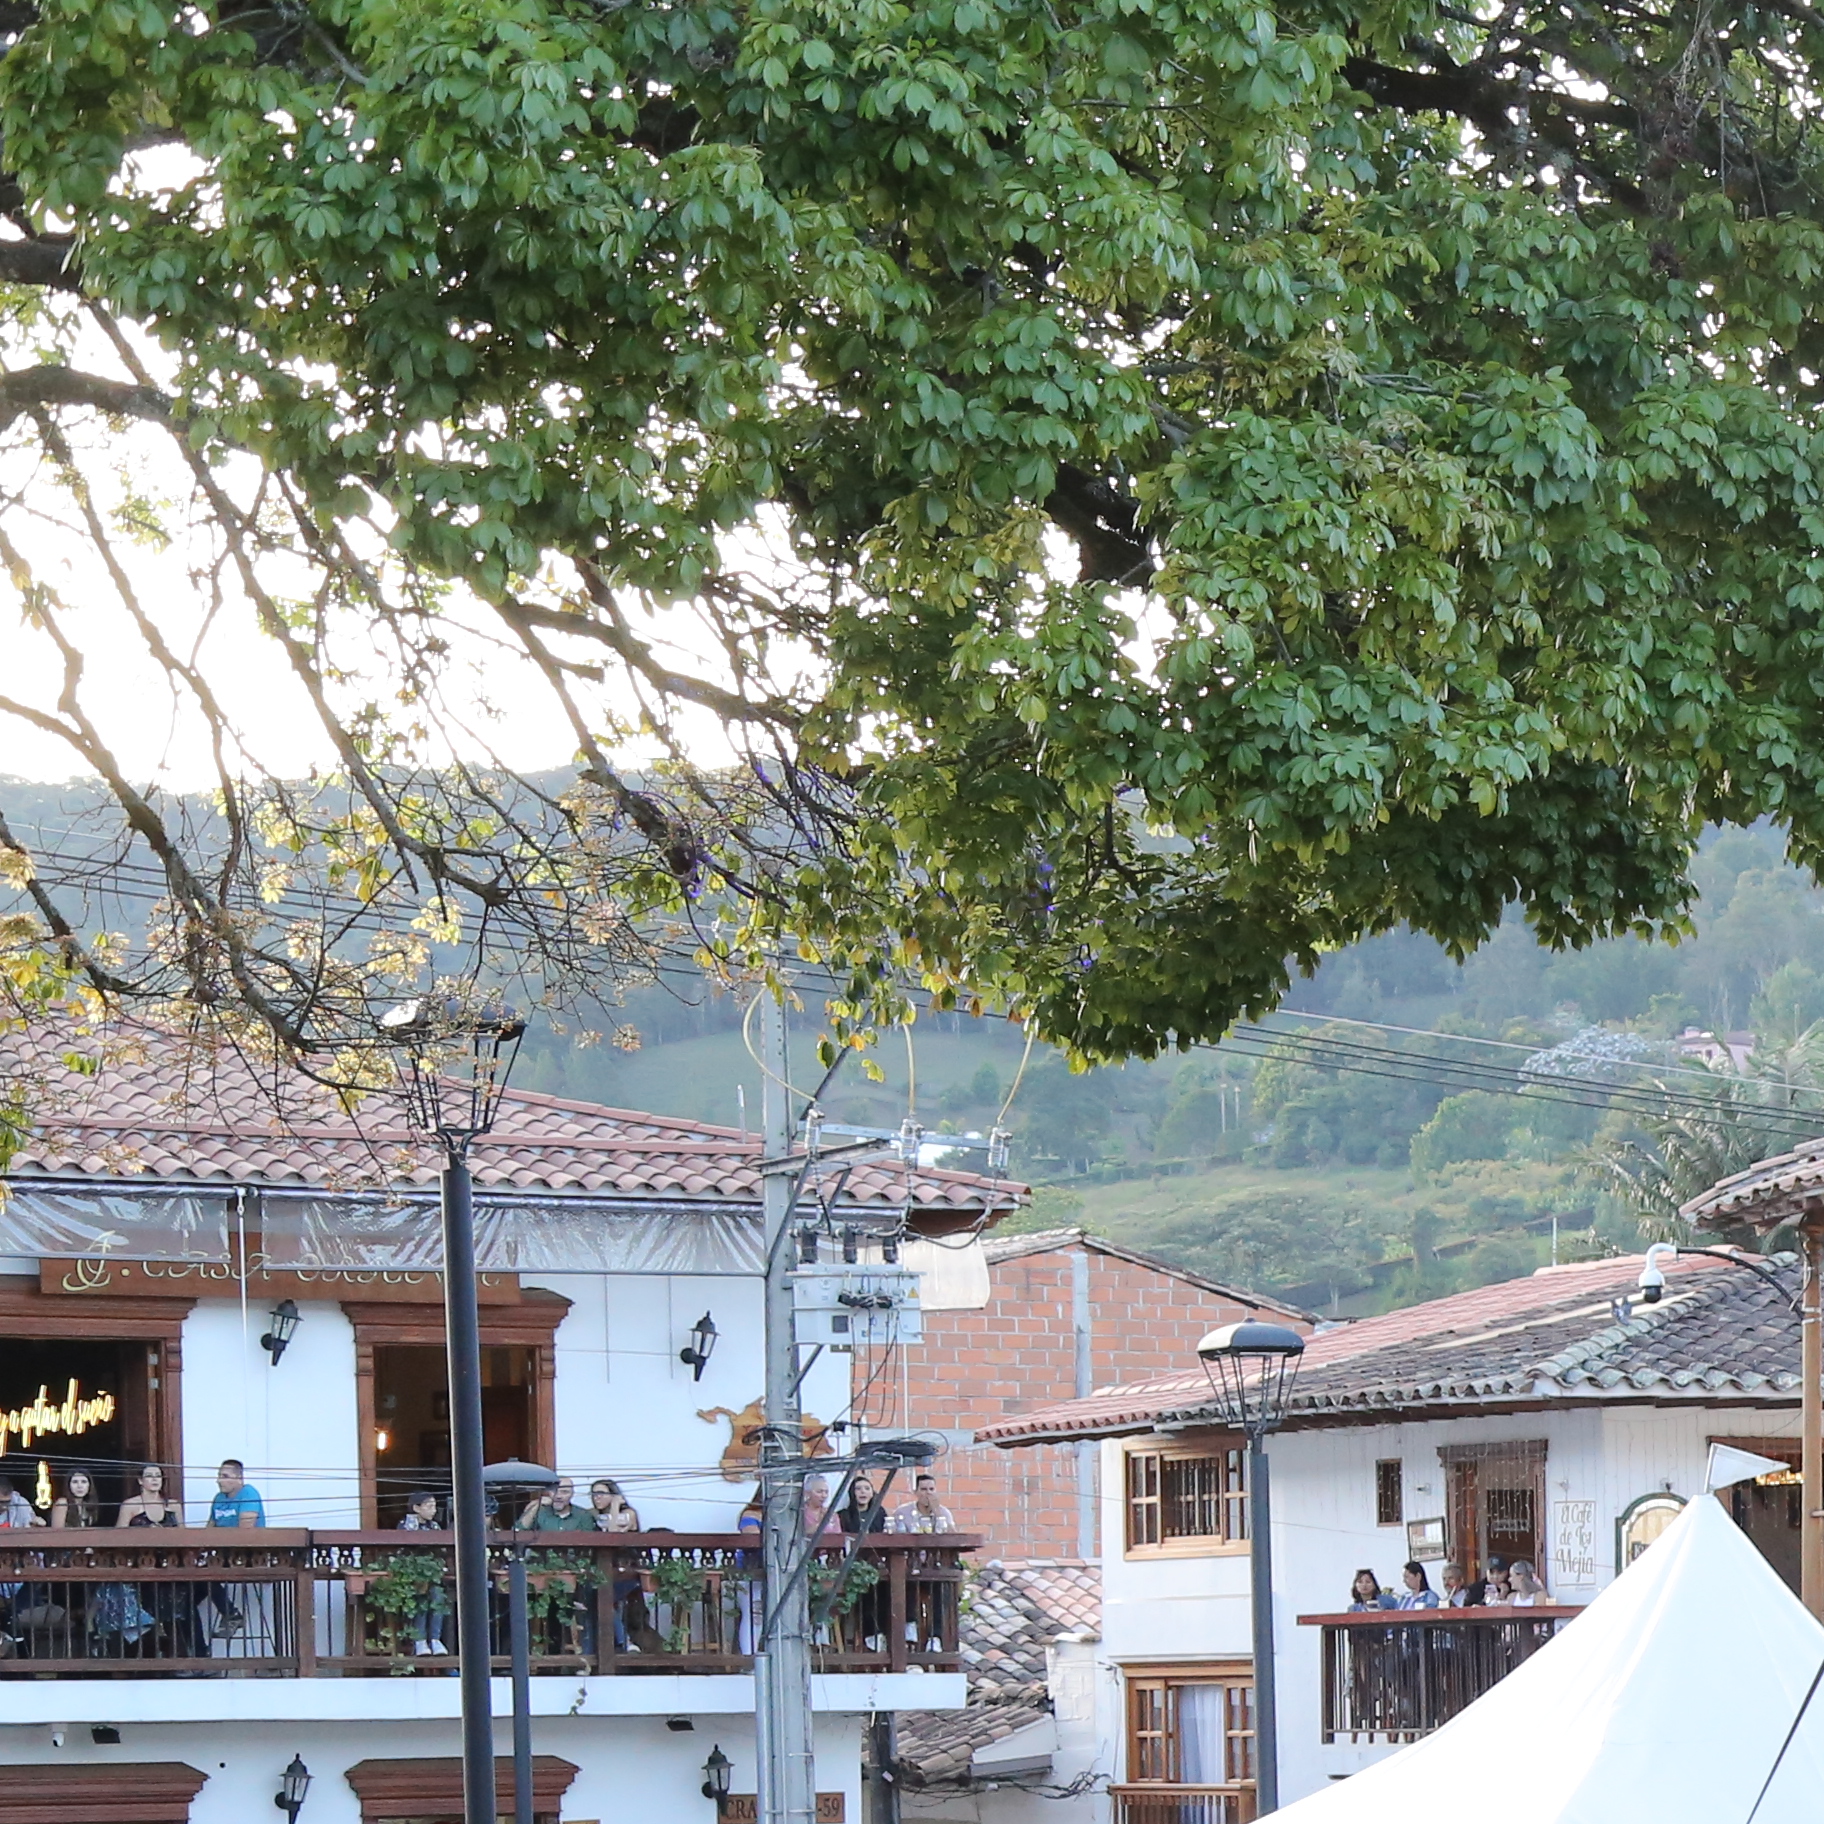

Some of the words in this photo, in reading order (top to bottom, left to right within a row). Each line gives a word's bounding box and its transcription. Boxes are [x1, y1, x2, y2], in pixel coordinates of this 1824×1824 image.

[1561, 1504, 1570, 1524] El
[1571, 1502, 1592, 1528] Café
[1560, 1527, 1571, 1545] de
